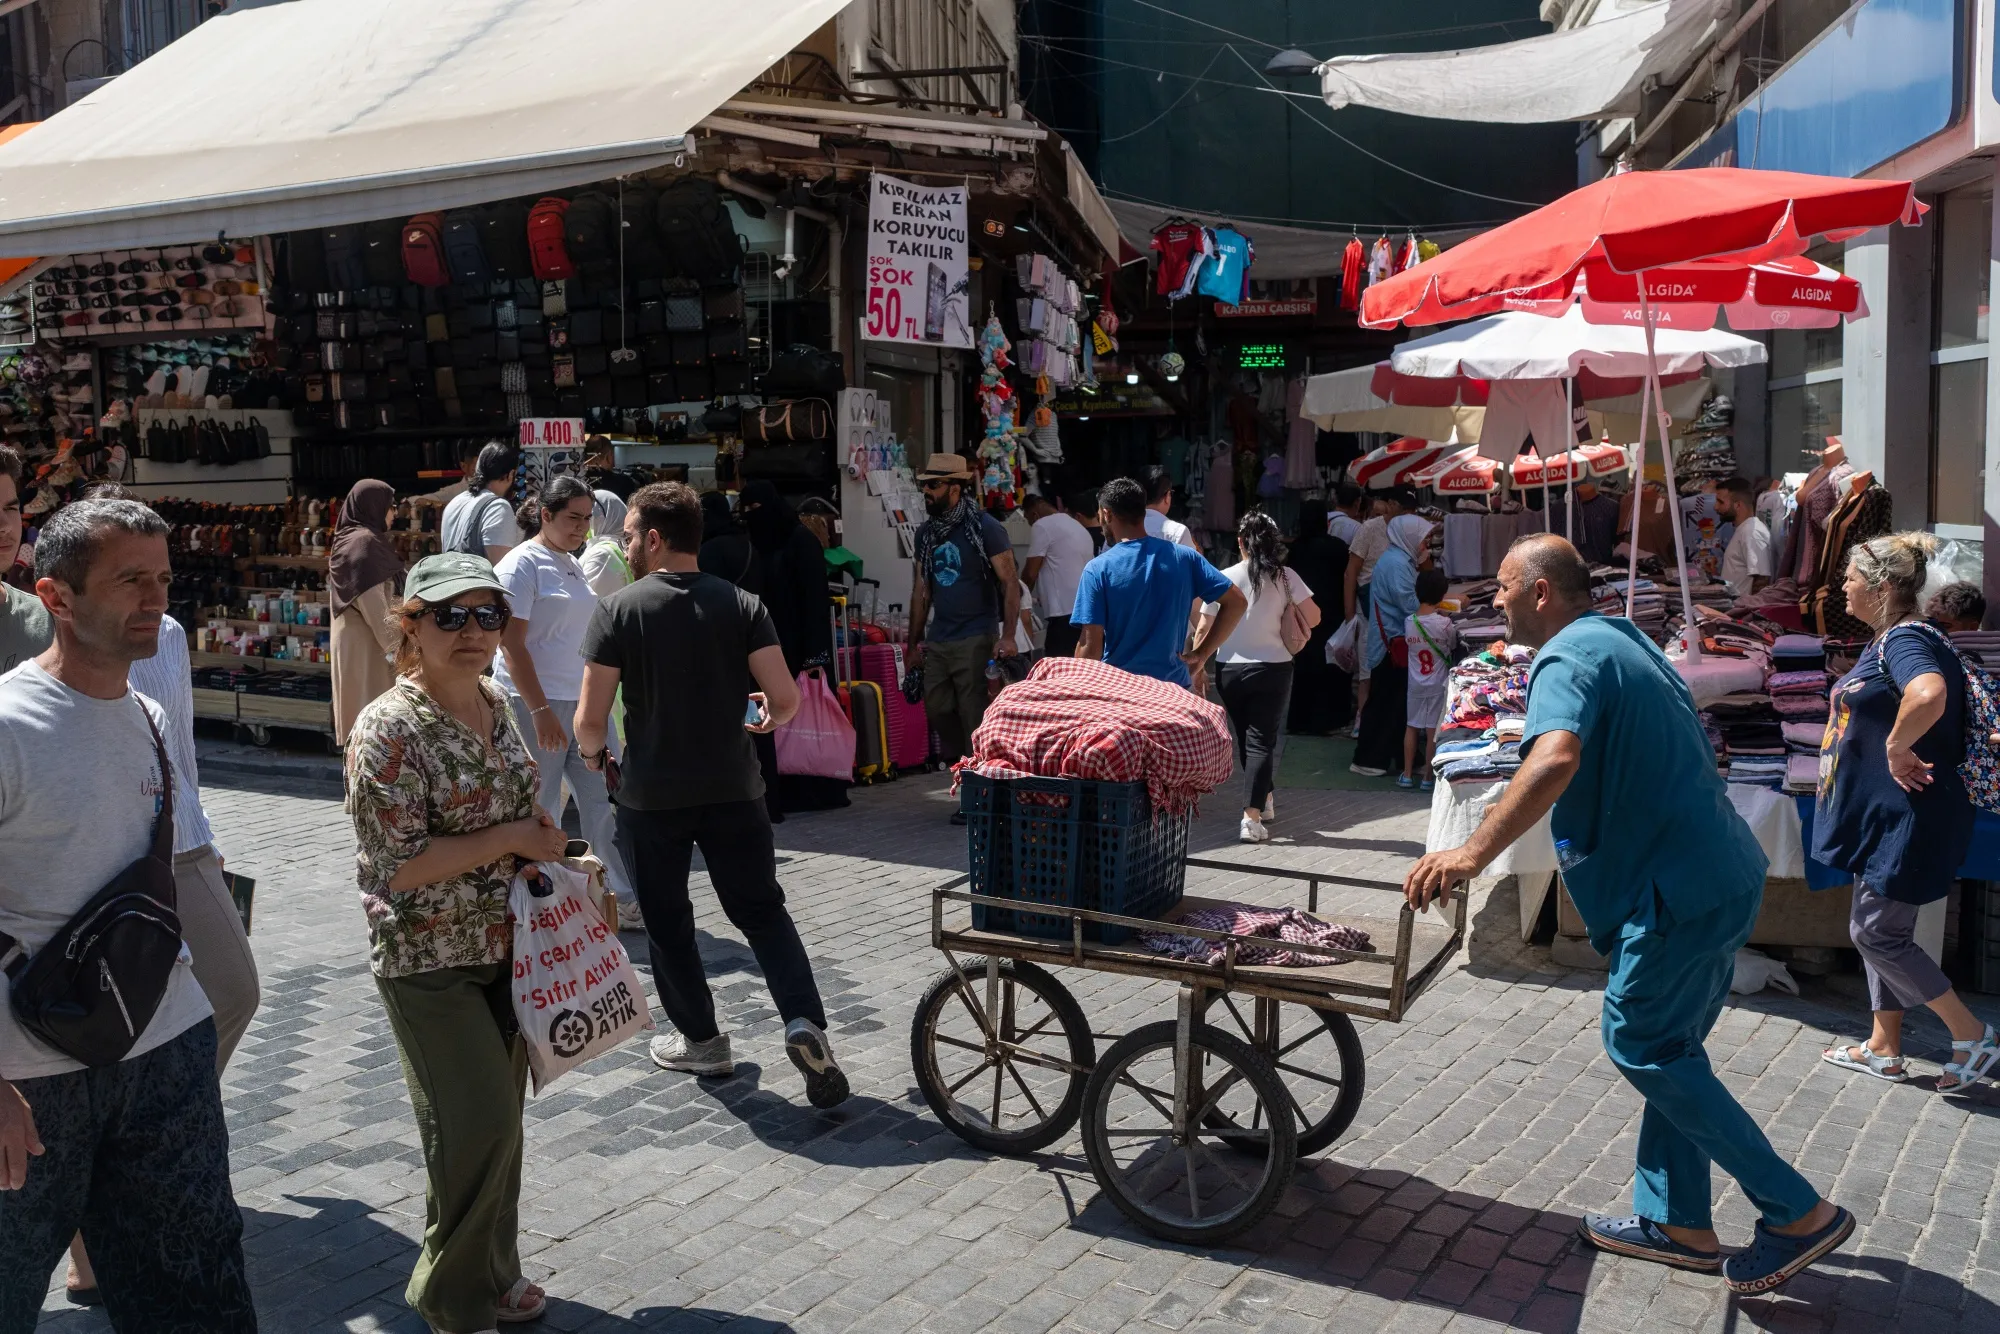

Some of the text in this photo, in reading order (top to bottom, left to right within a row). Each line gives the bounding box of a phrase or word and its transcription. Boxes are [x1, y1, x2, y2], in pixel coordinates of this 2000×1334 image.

[879, 181, 962, 205] KIRILMAZ
[892, 202, 952, 222] EKRAN
[873, 219, 965, 243] KORUYUCU
[869, 256, 893, 266] ŞOK
[887, 240, 953, 260] TAKILIR
[869, 267, 914, 287] ŞOK
[867, 287, 919, 340] 50 TL
[1222, 303, 1311, 316] KAFTAN ÇARŞISI
[520, 421, 535, 445] 00
[543, 421, 571, 445] 400
[1418, 650, 1433, 675] 8
[514, 954, 532, 980] bi
[591, 981, 631, 1021] SIFIR
[598, 997, 638, 1040] ATIK
[1738, 1271, 1786, 1292] crocs
